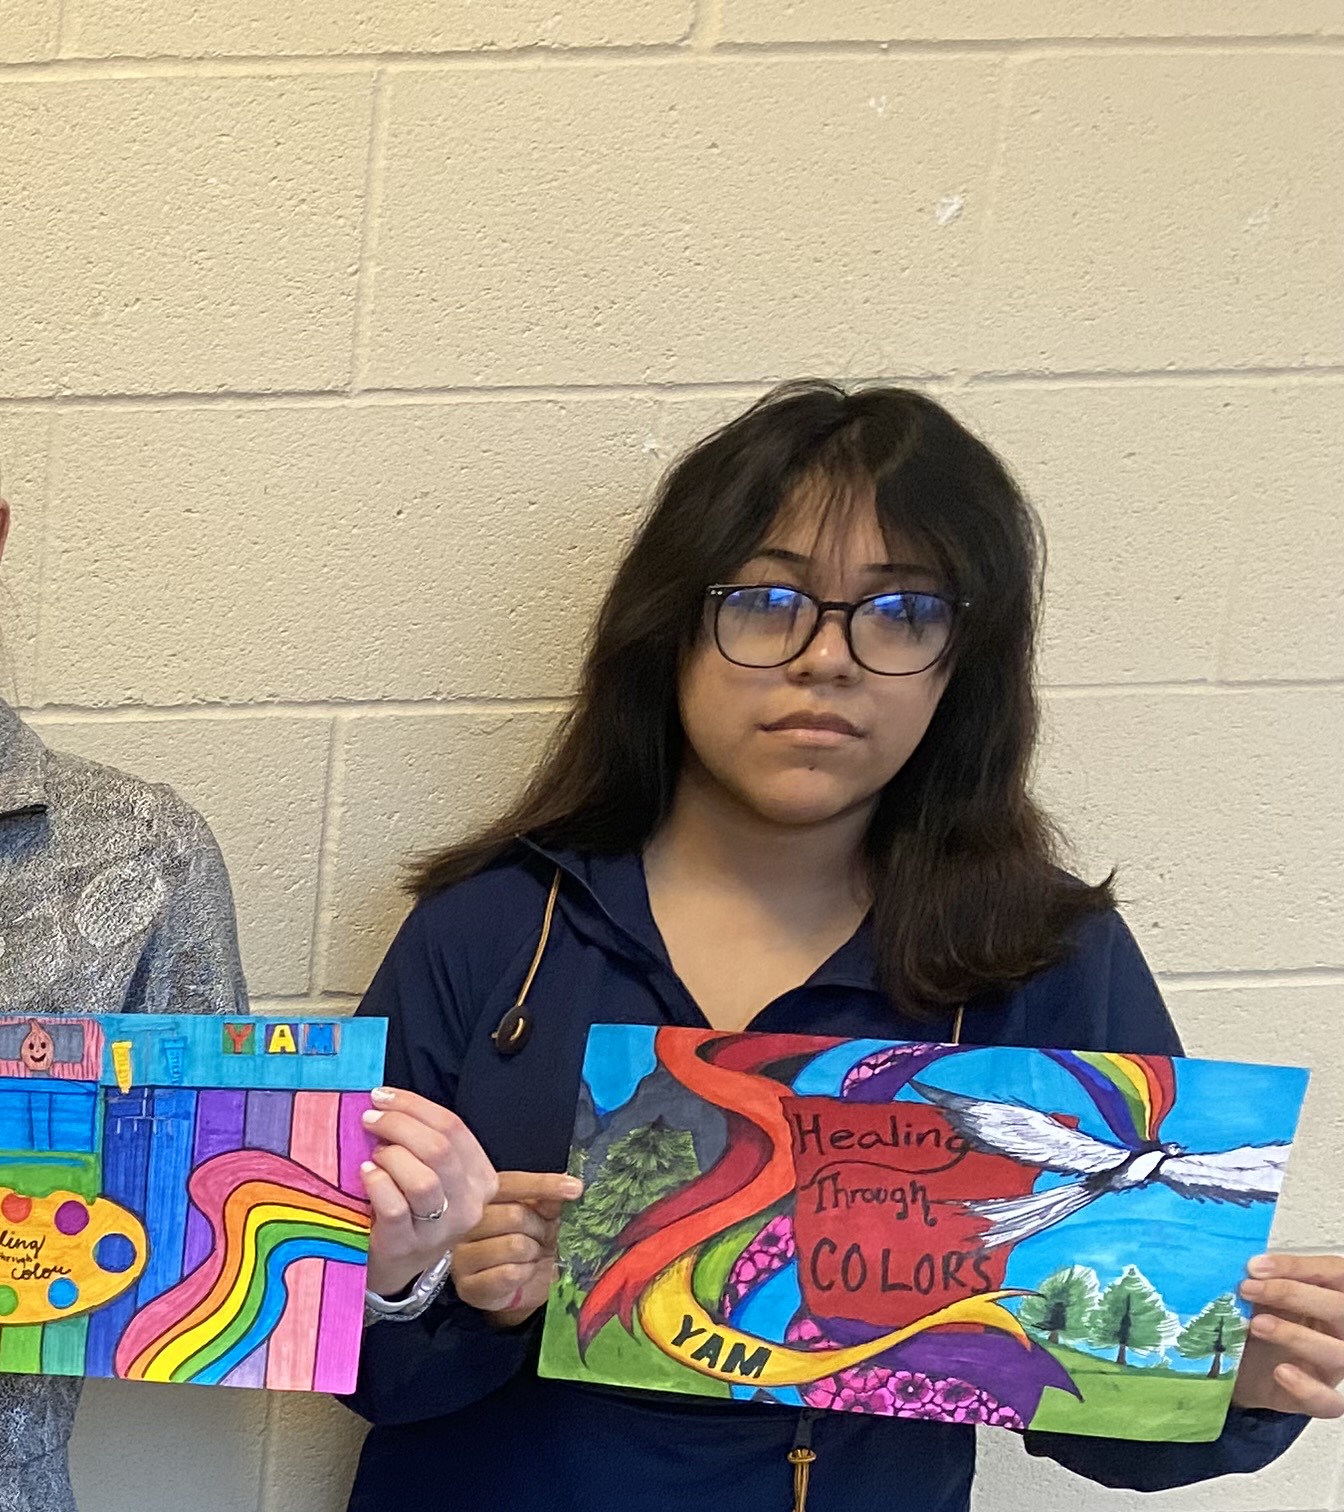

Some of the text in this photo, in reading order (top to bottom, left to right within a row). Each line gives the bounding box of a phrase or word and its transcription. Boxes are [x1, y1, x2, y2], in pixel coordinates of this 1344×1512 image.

[224, 1023, 336, 1053] YAM
[793, 1112, 972, 1184] Healing
[813, 1171, 938, 1227] Through
[810, 1237, 992, 1294] COLORS
[671, 1314, 772, 1379] YAM
